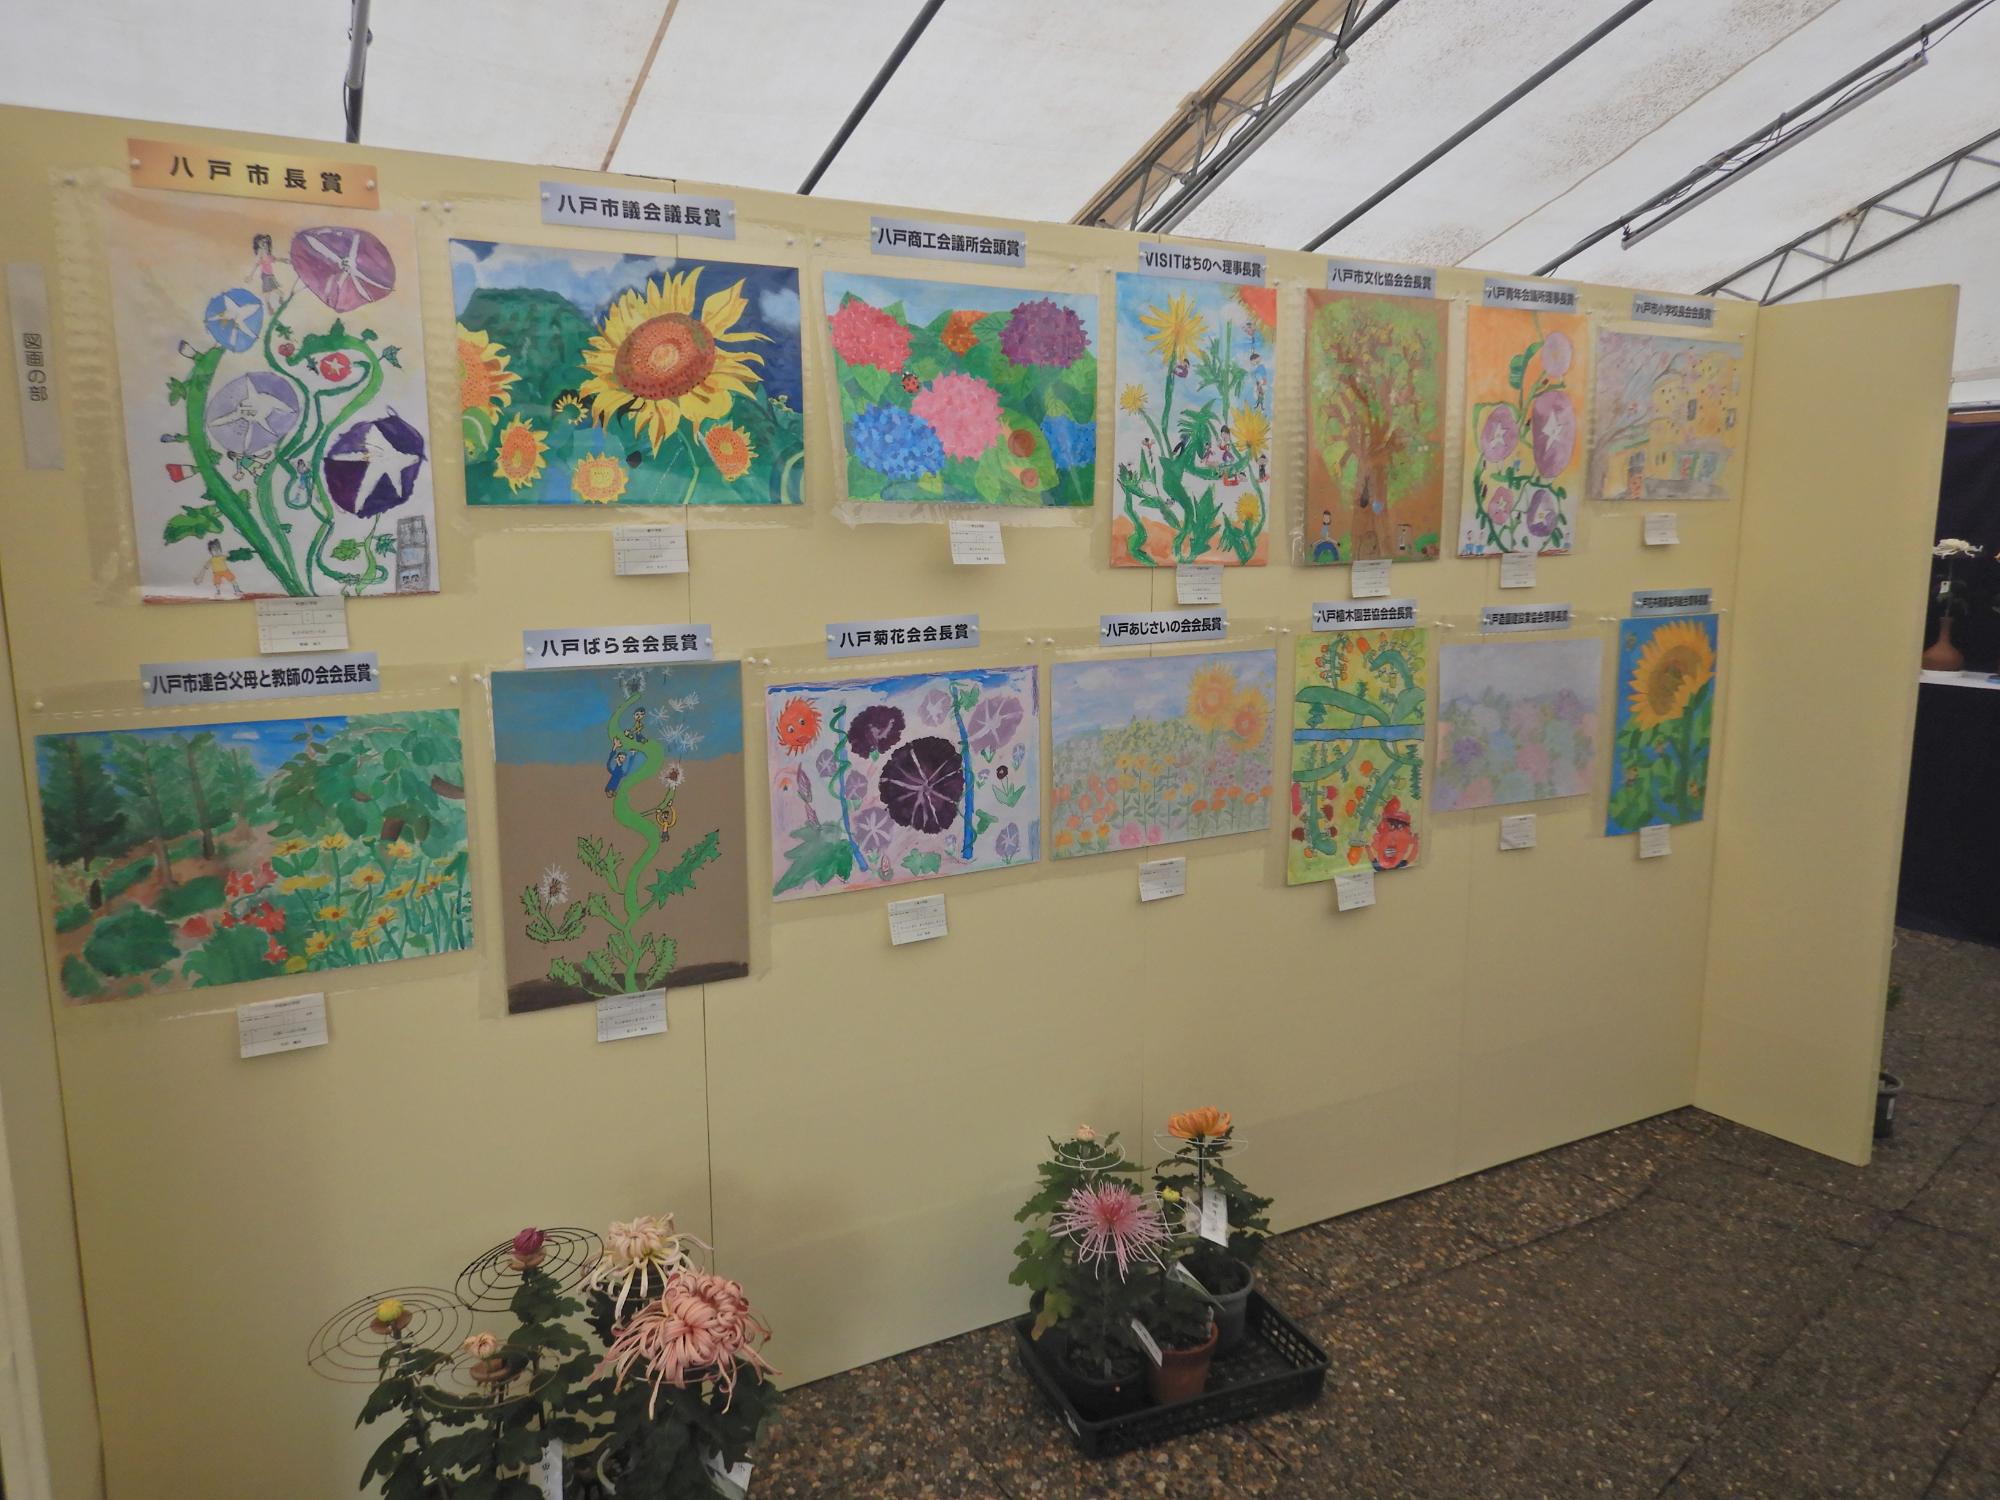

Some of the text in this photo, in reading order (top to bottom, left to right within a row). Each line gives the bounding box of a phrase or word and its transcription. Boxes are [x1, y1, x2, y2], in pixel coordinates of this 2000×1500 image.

[170, 155, 344, 195] 八戸市長賞
[558, 194, 722, 228] 八戸市議会議長賞
[878, 228, 1020, 258] 八戸商工会議所会頭賞
[1145, 250, 1261, 278] VISITはちのへ理事長賞
[1332, 267, 1432, 291] 八戸市文化協会会長賞
[23, 333, 49, 402] 図画の部
[839, 623, 969, 649] 八戸菊花会会長賞
[1106, 617, 1222, 637] 八戸あじさいの会会長賞
[541, 633, 698, 658] 八戸ばら会会長賞
[152, 663, 372, 694] 八戸市連合父母と教師の会会長賞
